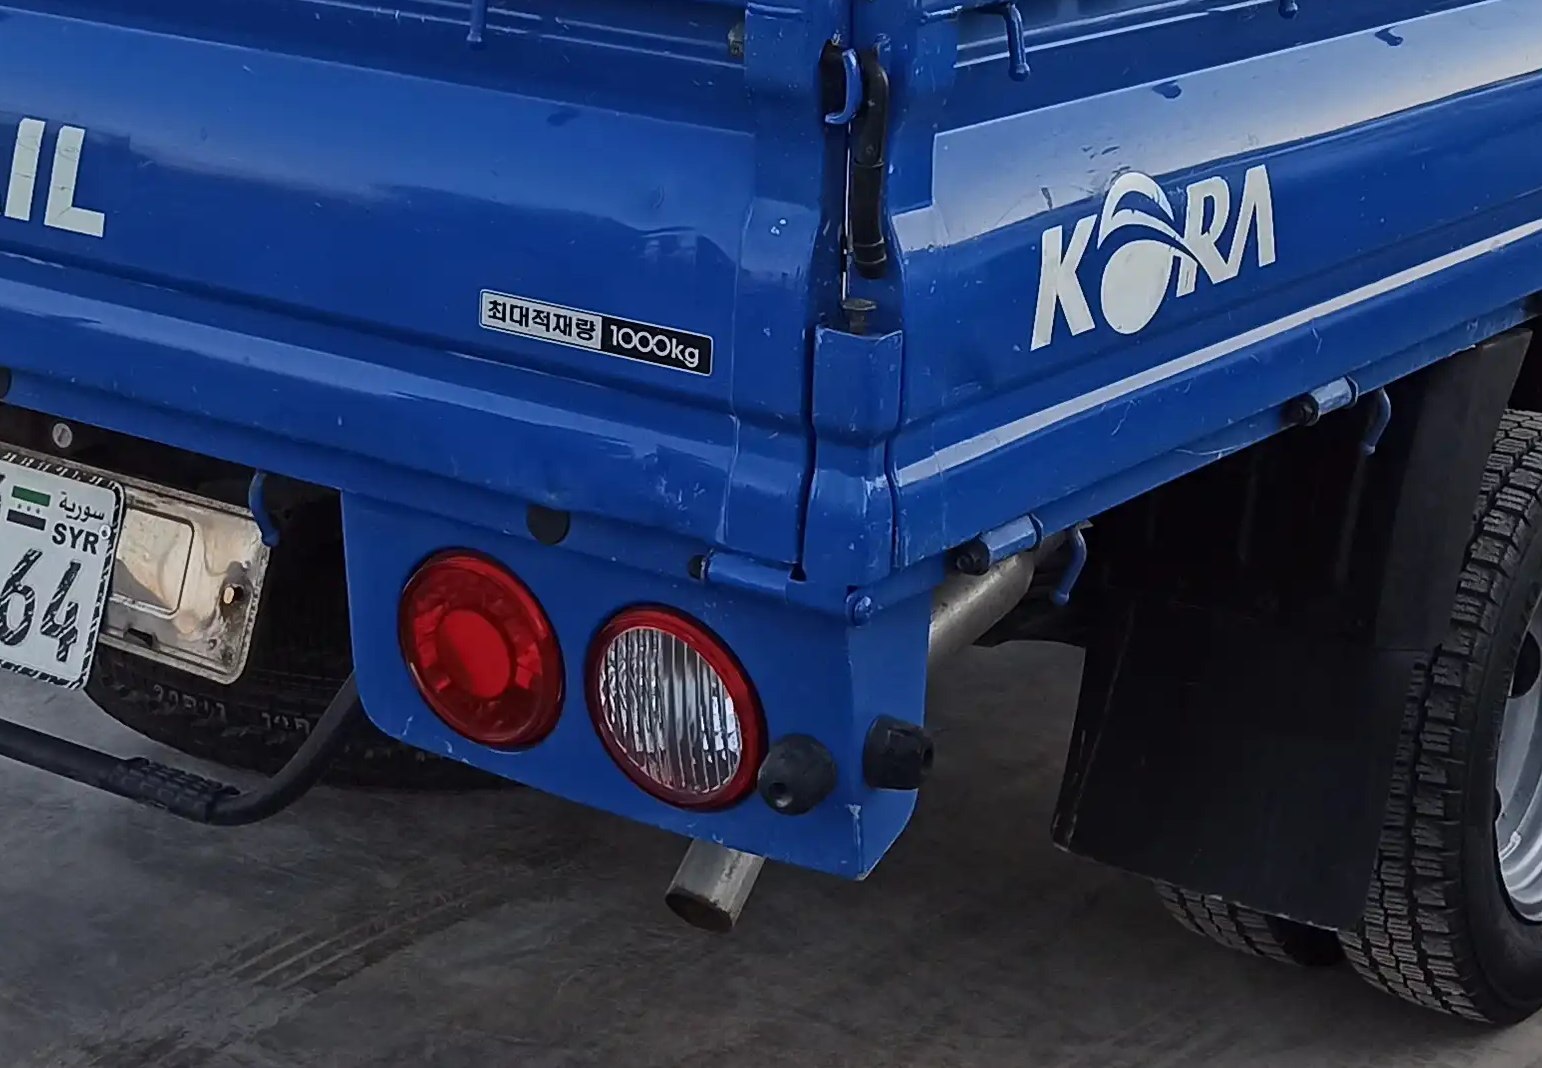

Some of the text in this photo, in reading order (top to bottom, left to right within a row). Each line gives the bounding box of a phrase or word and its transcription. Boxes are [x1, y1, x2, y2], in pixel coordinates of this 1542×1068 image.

[487, 300, 596, 342] 최대적재량
[610, 324, 700, 368] 1000kg
[58, 491, 105, 522] سورية
[51, 522, 100, 555] SYR
